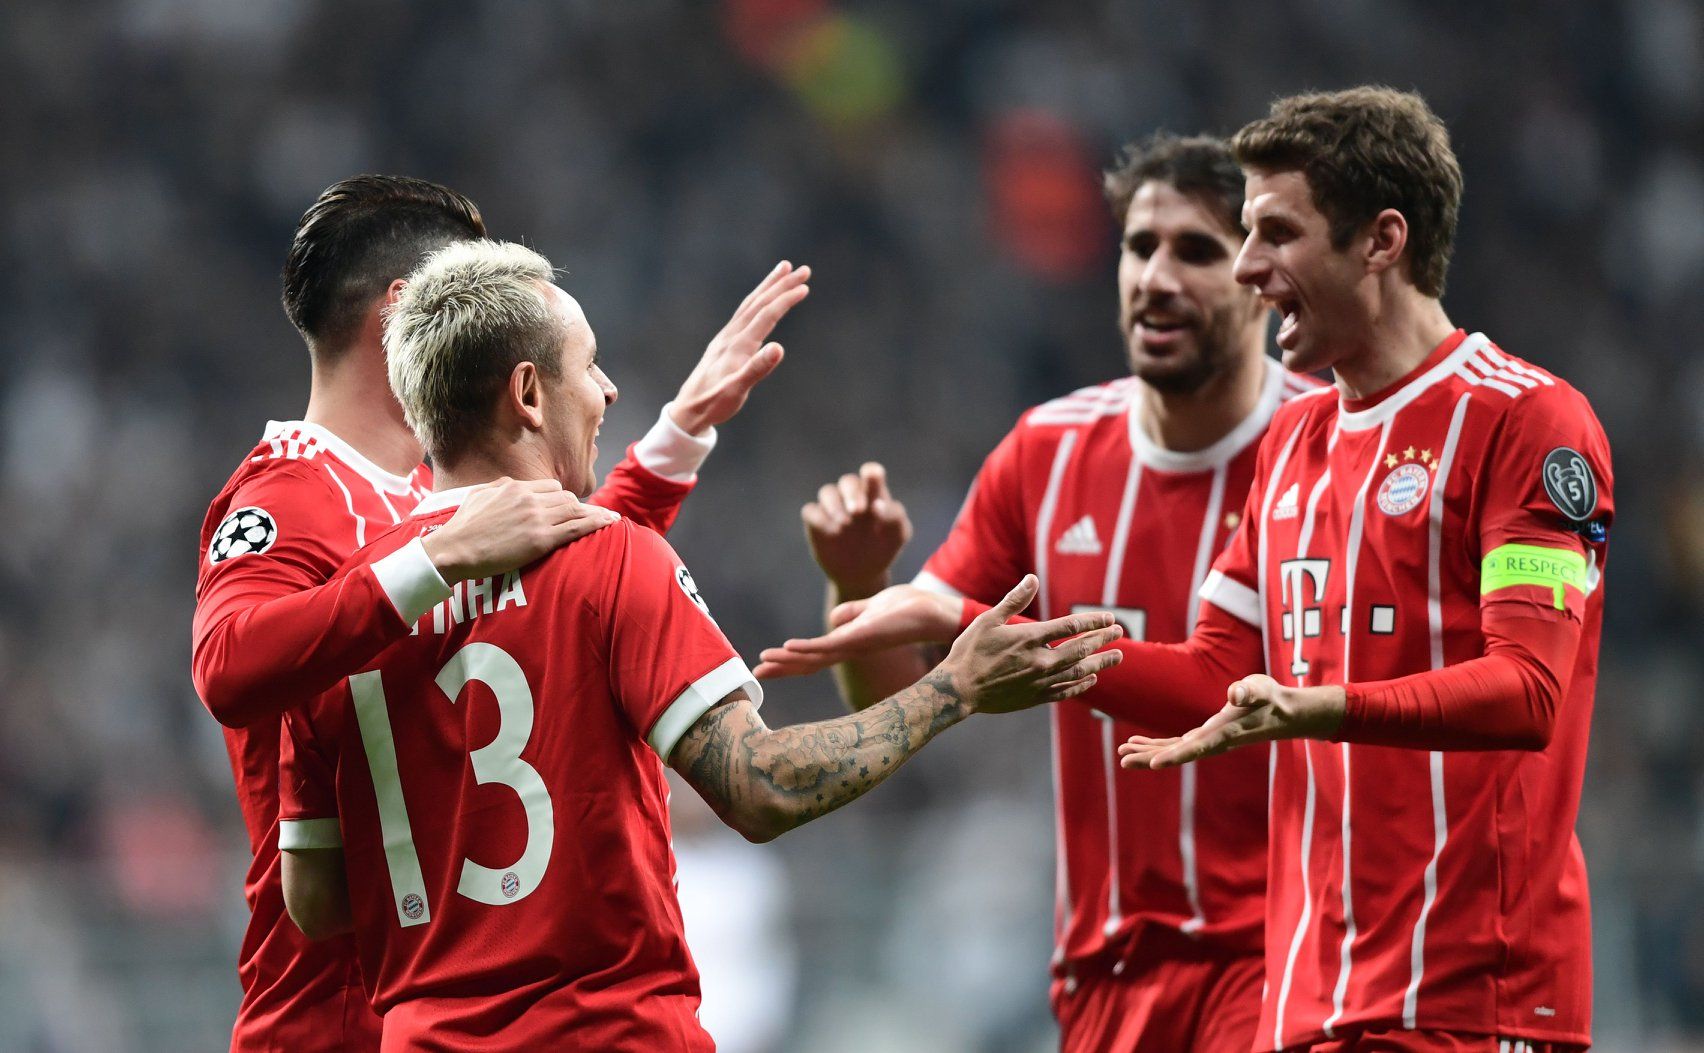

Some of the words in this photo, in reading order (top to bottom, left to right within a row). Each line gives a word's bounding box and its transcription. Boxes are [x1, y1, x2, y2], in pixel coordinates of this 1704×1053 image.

[1568, 481, 1581, 500] 5
[409, 566, 528, 636] INHA
[349, 642, 555, 928] 13
